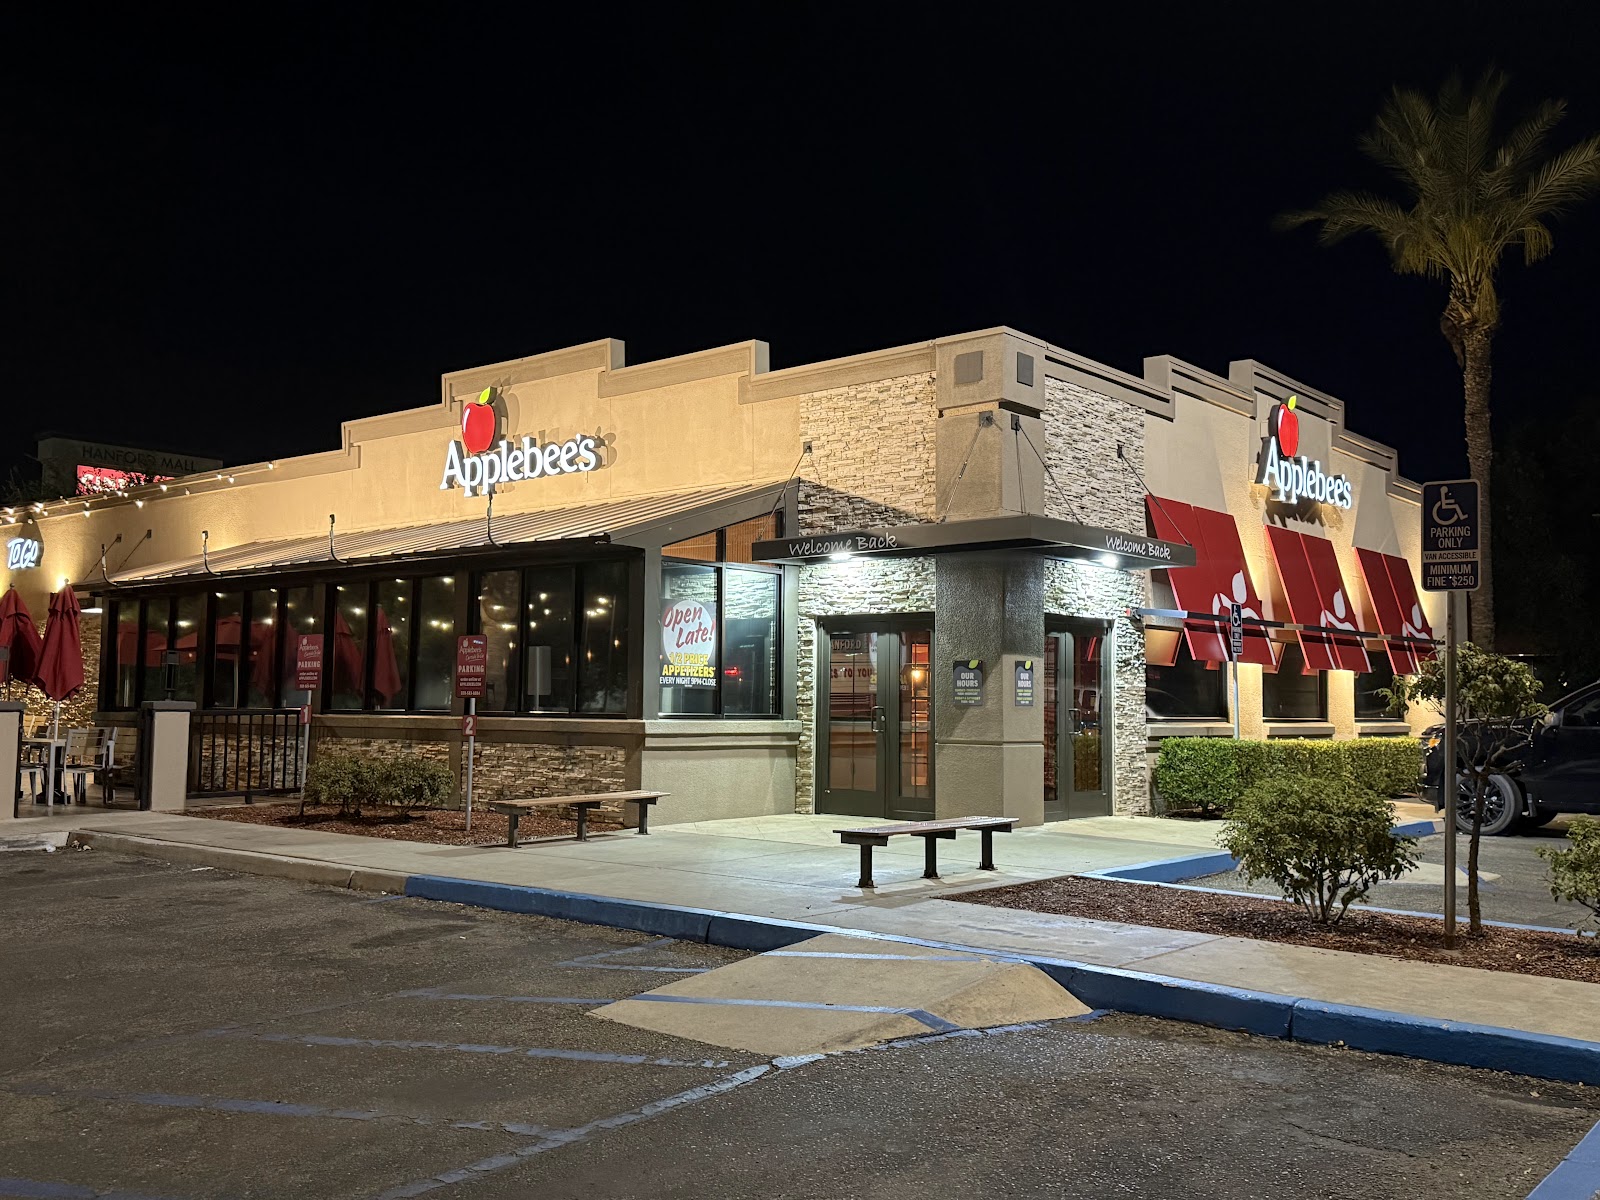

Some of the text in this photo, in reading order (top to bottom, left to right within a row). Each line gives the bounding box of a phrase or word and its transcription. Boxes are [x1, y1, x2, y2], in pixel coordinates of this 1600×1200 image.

[82, 445, 197, 472] HANFORD MALL
[440, 434, 597, 497] Applebee's
[1263, 436, 1352, 509] Applebee's
[1430, 526, 1471, 538] PARKING
[789, 532, 898, 556] Welcome Back
[1106, 535, 1171, 560] Welcome Back
[1438, 537, 1463, 549] ONLY
[1425, 551, 1477, 560] VAN ACCESSIBLE
[1430, 564, 1472, 575] MINIMUM
[1427, 575, 1475, 587] FINE $250
[662, 606, 703, 632] Open
[676, 620, 716, 649] Late!
[297, 660, 321, 668] PARKING
[684, 653, 709, 665] PRICE
[458, 665, 485, 673] PARKING
[660, 676, 675, 684] EVERY
[675, 677, 690, 685] NIGHT
[960, 672, 975, 680] OUR
[1020, 672, 1029, 680] OUR
[1017, 680, 1031, 688] HOURS
[303, 705, 309, 723] 1
[465, 716, 474, 735] 2
